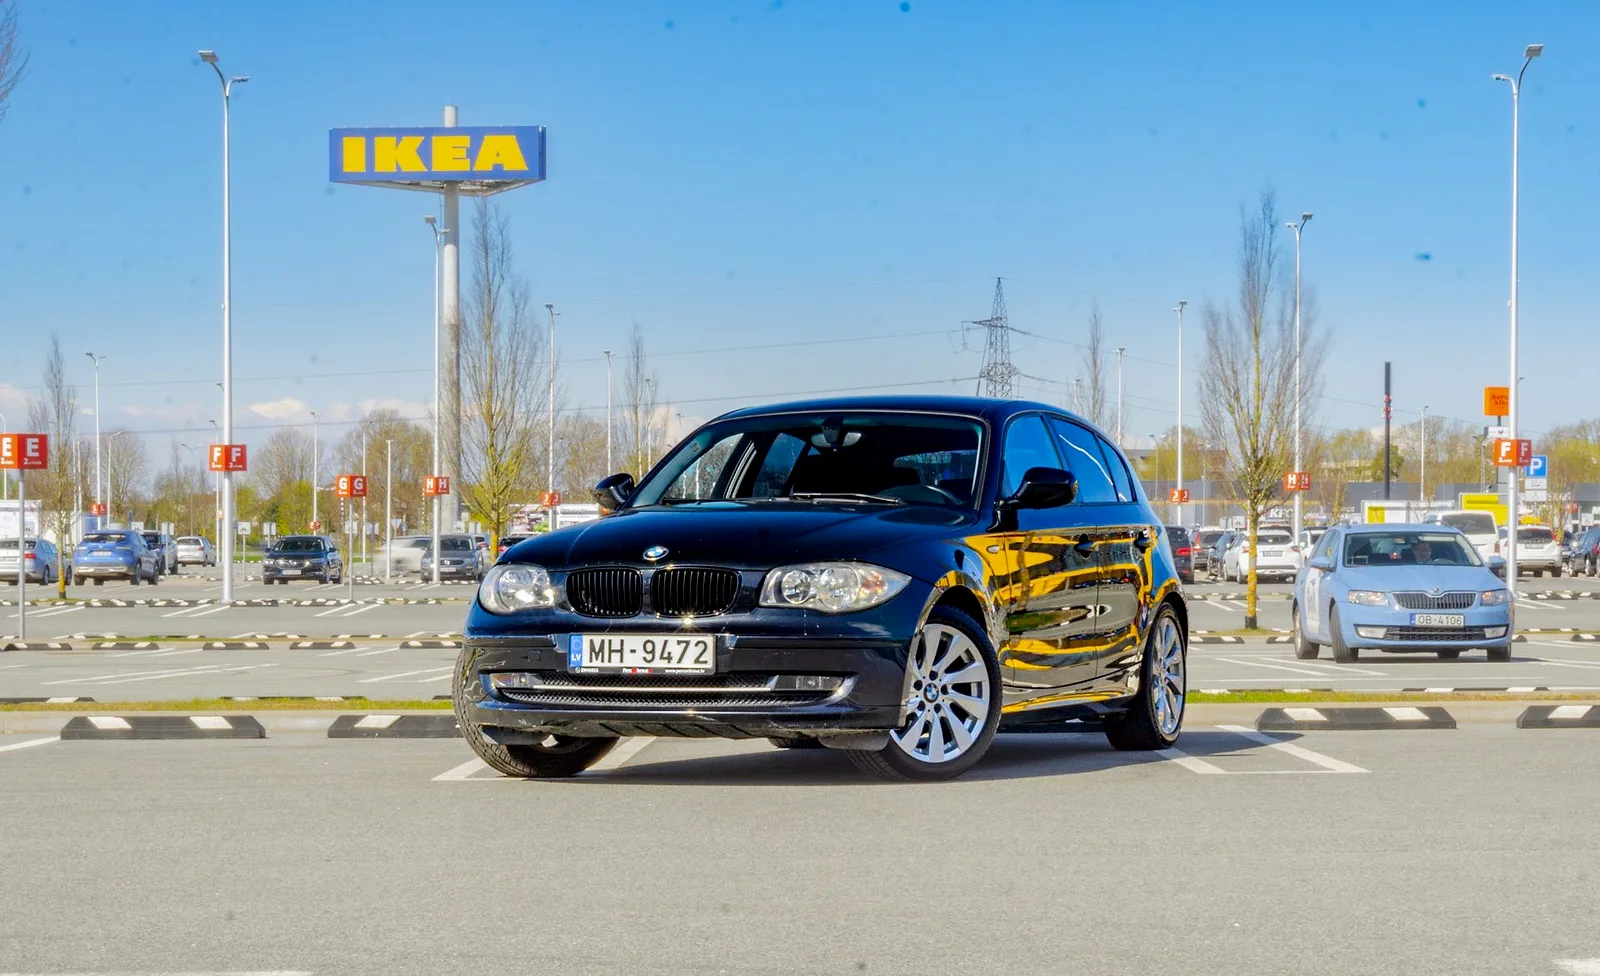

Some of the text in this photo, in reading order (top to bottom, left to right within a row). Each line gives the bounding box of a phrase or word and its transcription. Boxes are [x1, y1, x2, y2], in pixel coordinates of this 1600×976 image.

[342, 135, 529, 172] IKEA
[2, 437, 12, 457] E
[26, 437, 40, 457] E
[213, 447, 222, 462] F
[231, 447, 241, 462] F
[1500, 441, 1511, 457] F
[1521, 442, 1529, 457] F
[1529, 457, 1543, 476] P
[338, 477, 348, 490] G
[353, 477, 364, 490] G
[426, 478, 434, 489] H
[439, 478, 447, 489] H
[1287, 473, 1296, 485] H
[1270, 508, 1293, 518] KFC
[1418, 615, 1462, 625] OB-4106
[571, 654, 582, 662] LV
[588, 639, 709, 664] MH-9472
